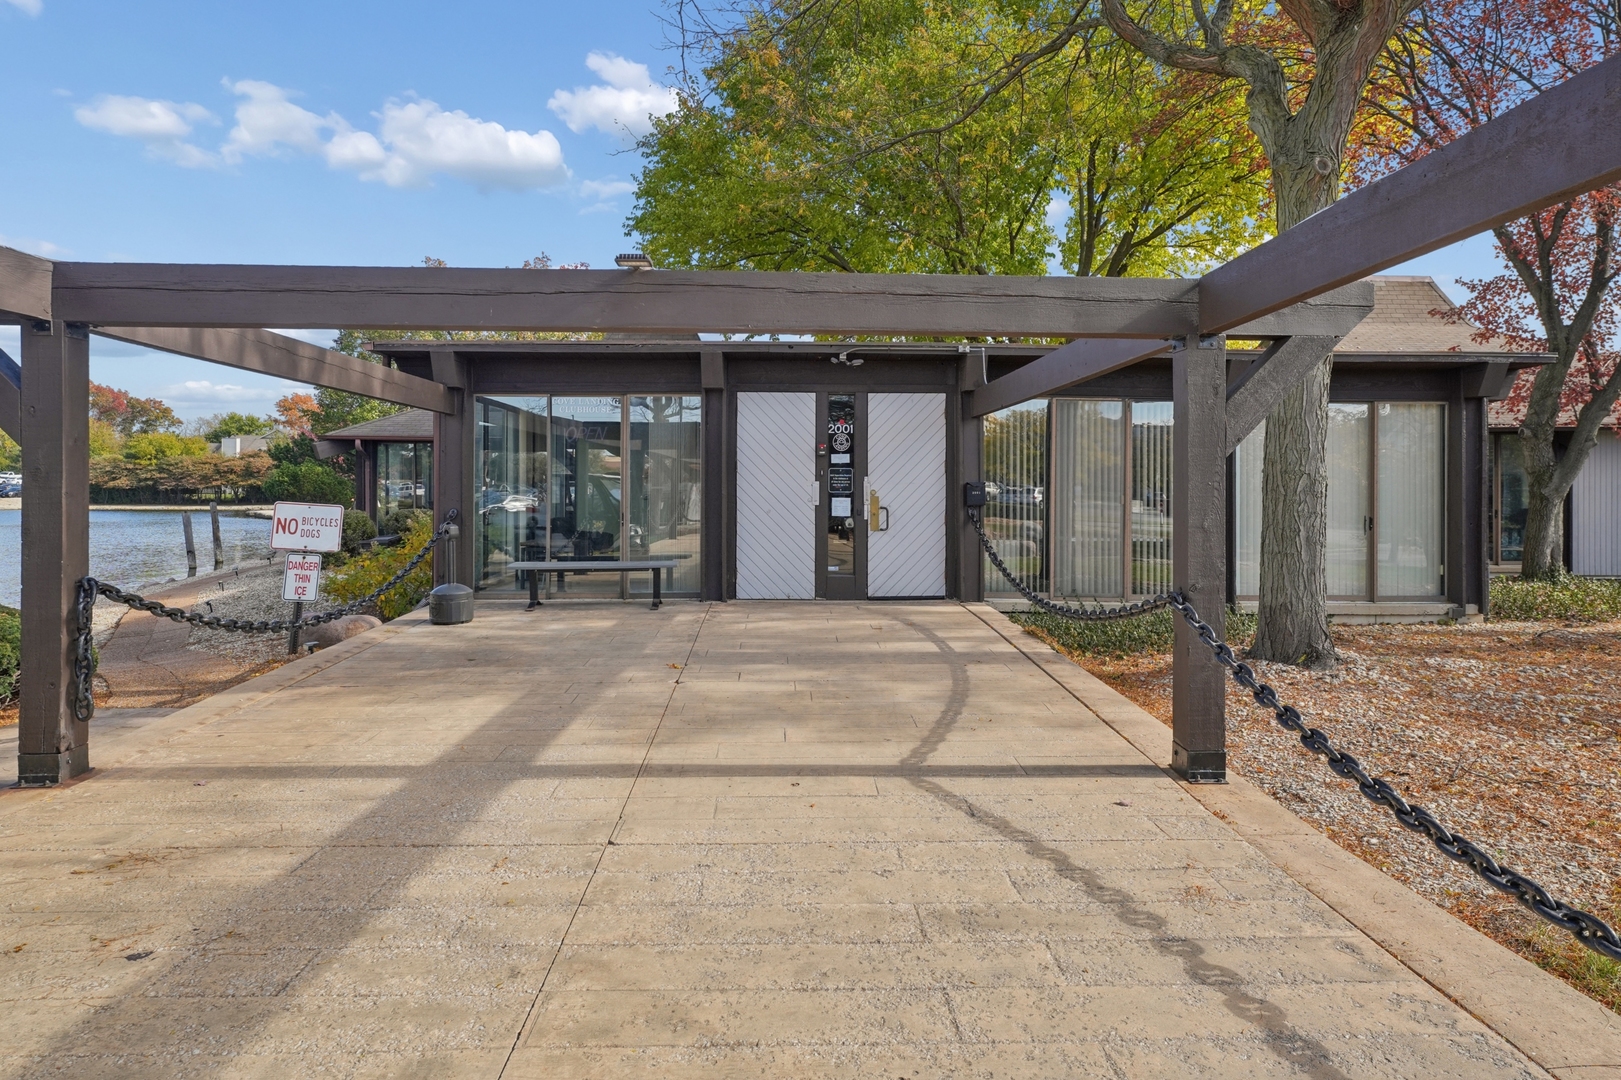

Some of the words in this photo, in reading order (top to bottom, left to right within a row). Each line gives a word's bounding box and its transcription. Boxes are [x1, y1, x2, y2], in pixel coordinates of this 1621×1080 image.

[565, 426, 608, 442] OPEN
[828, 424, 853, 434] 2001
[275, 517, 299, 535] NO
[301, 516, 339, 528] BICYCLES
[300, 529, 321, 539] DOGS
[288, 560, 319, 571] DANGER
[294, 573, 311, 583] THIN
[294, 586, 307, 596] ICE
